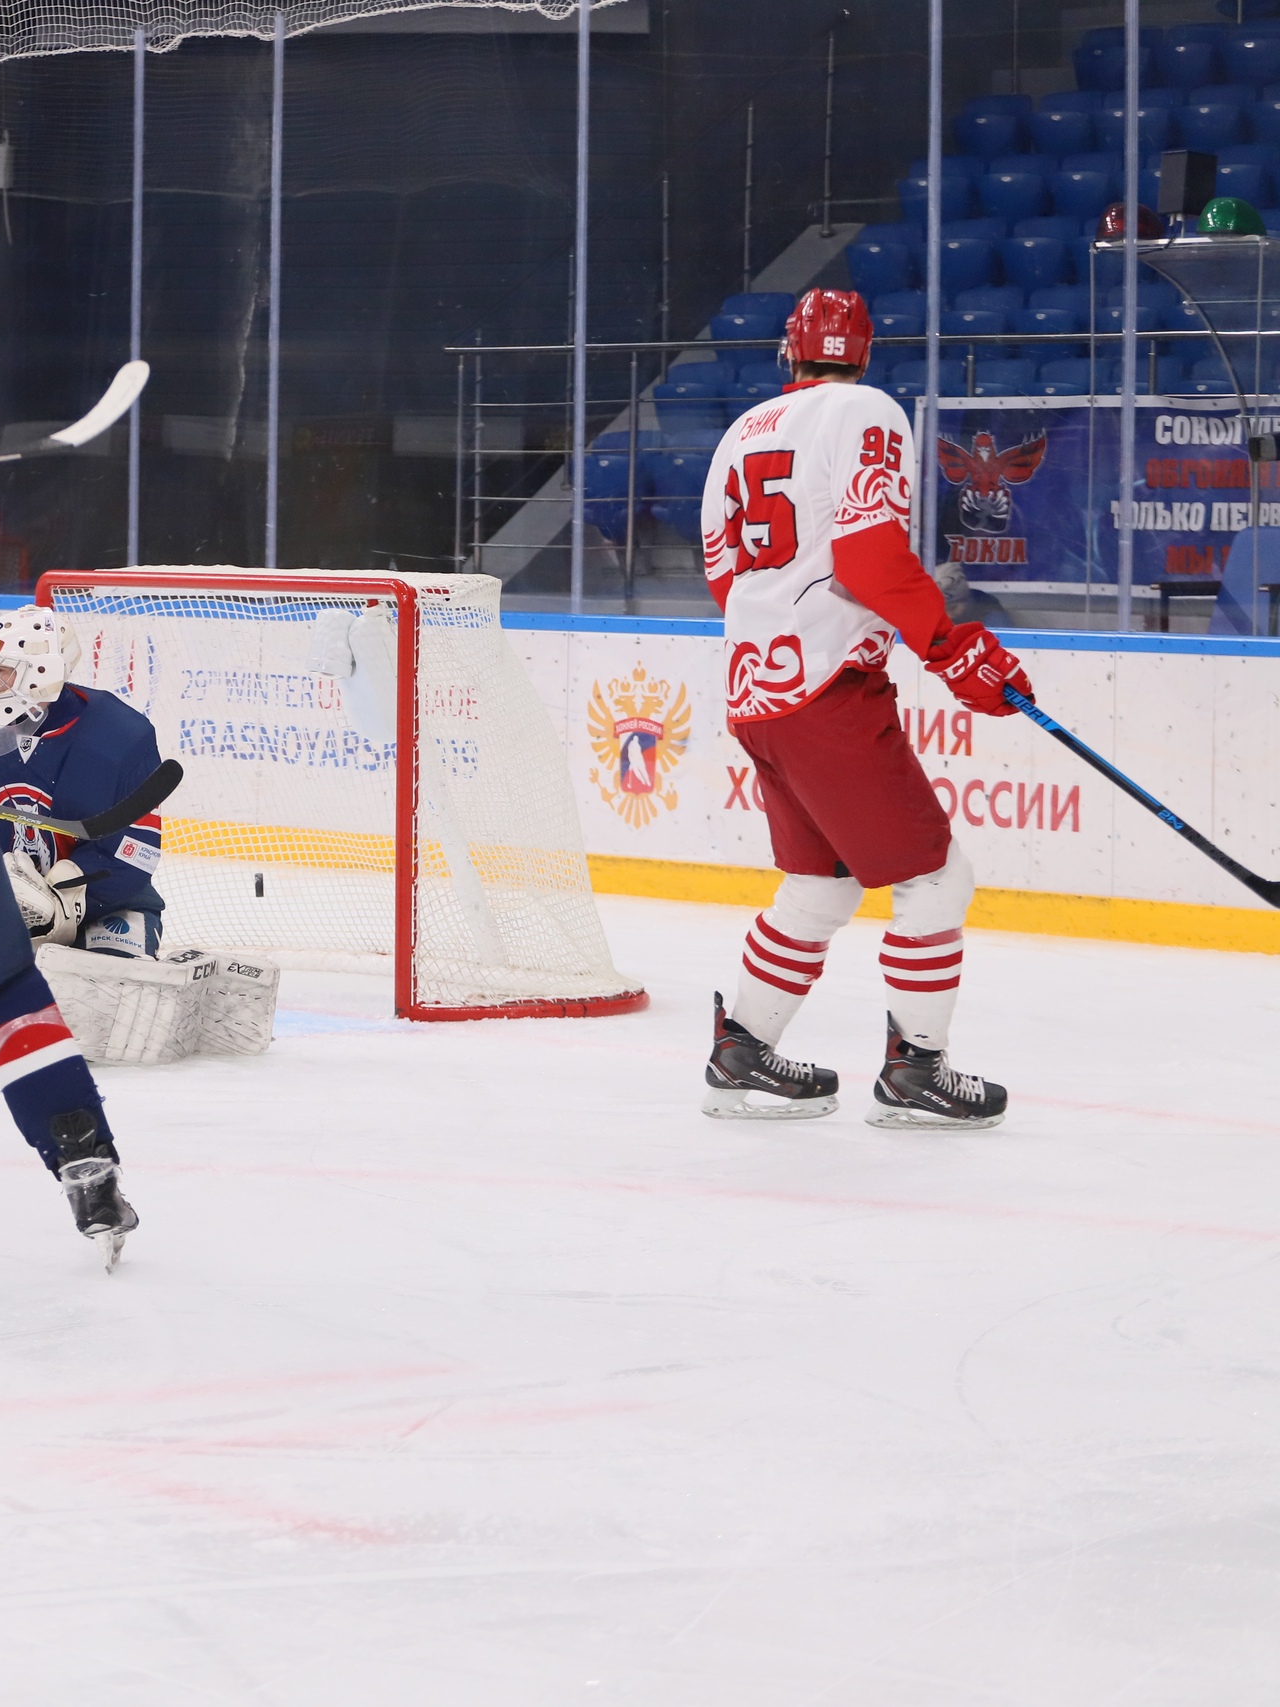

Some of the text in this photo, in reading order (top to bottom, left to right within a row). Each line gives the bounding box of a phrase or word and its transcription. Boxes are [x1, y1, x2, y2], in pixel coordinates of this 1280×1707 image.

[822, 335, 846, 357] 95
[1155, 414, 1241, 446] СОКОЛ
[860, 425, 903, 473] 95
[942, 636, 986, 680] CM
[1003, 687, 1044, 721] AUER
[933, 777, 1081, 833] ОССИИ
[192, 960, 218, 981] CCM
[749, 1070, 780, 1088] CCM
[922, 1090, 952, 1109] CCM
